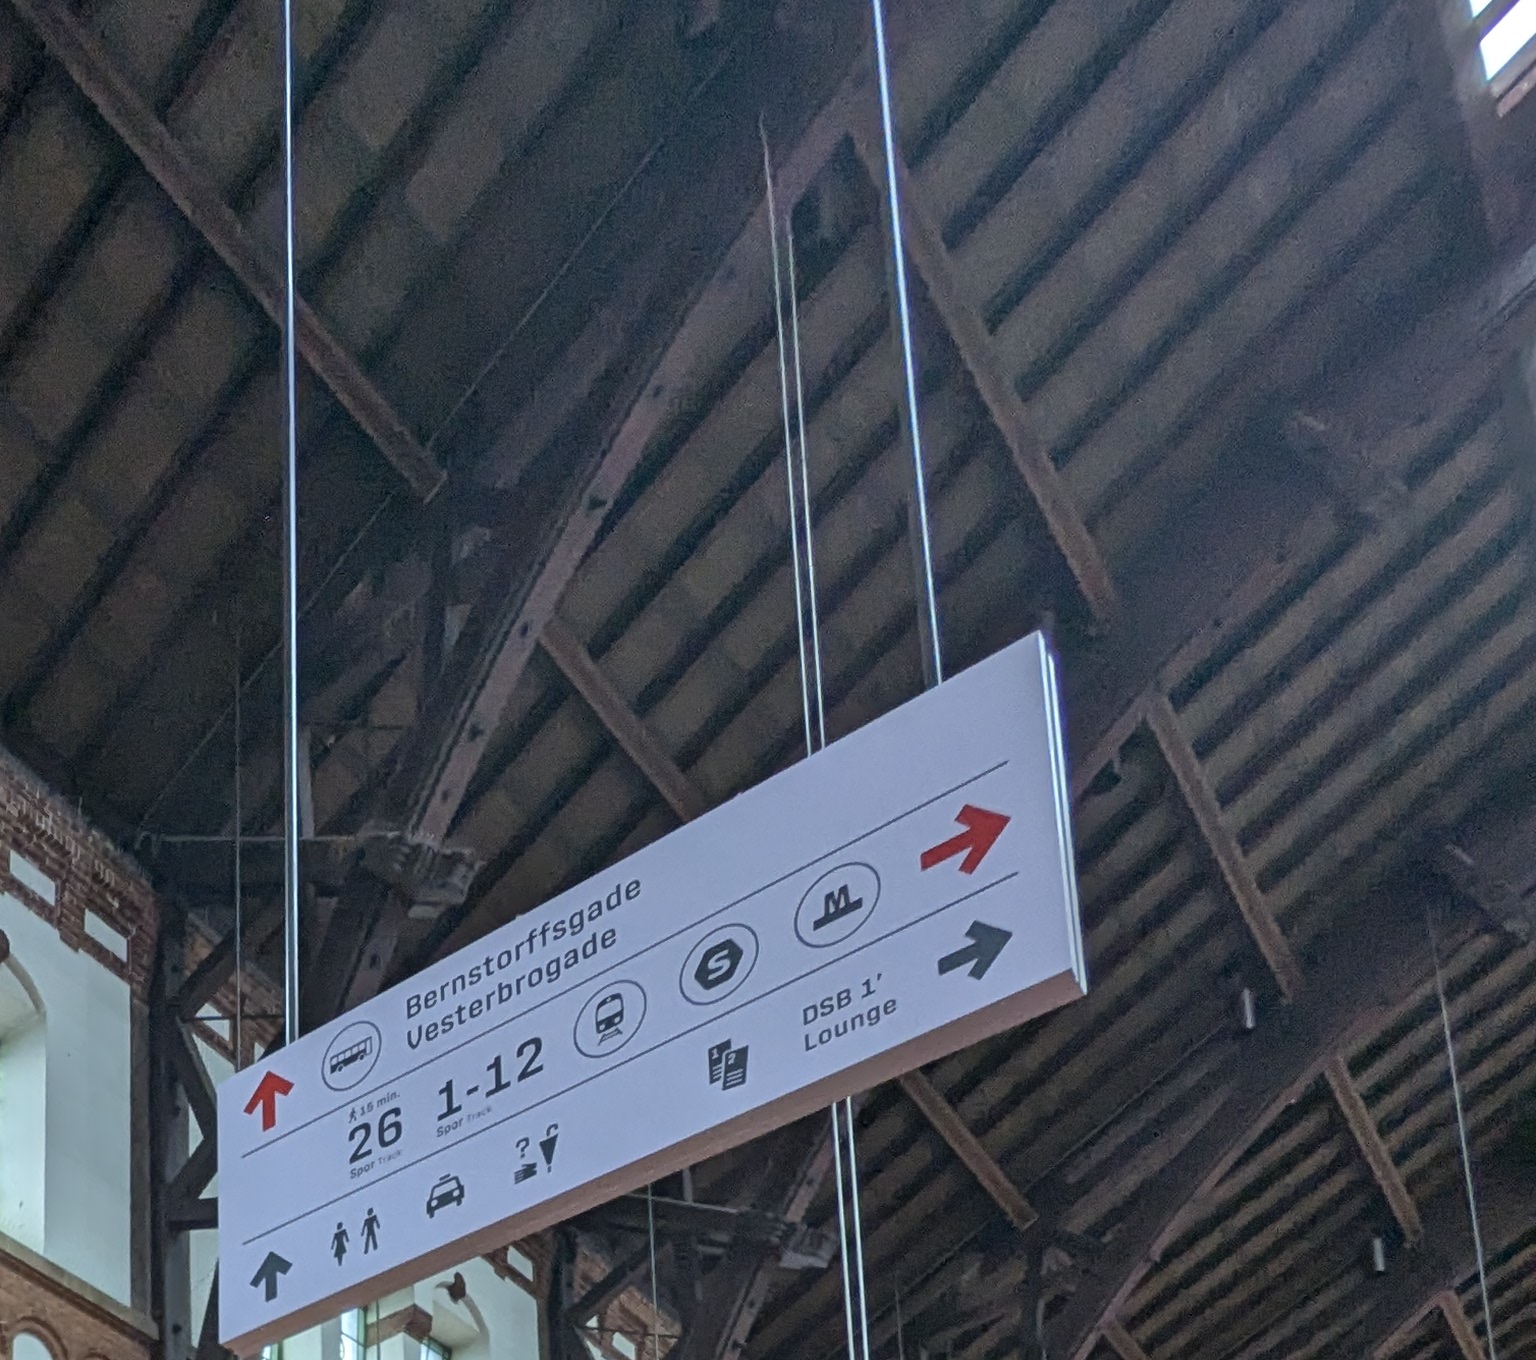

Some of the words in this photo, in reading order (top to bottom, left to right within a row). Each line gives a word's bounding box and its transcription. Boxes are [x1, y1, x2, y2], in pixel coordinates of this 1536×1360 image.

[406, 879, 641, 1020] Bernstorffsgade
[407, 928, 617, 1050] Vesterbrogade
[802, 987, 852, 1026] DSB
[804, 998, 897, 1051] Lounge
[437, 1036, 544, 1121] 1-12
[348, 1106, 402, 1165] 26
[436, 1117, 464, 1138] Spor
[350, 1161, 376, 1180] Spor
